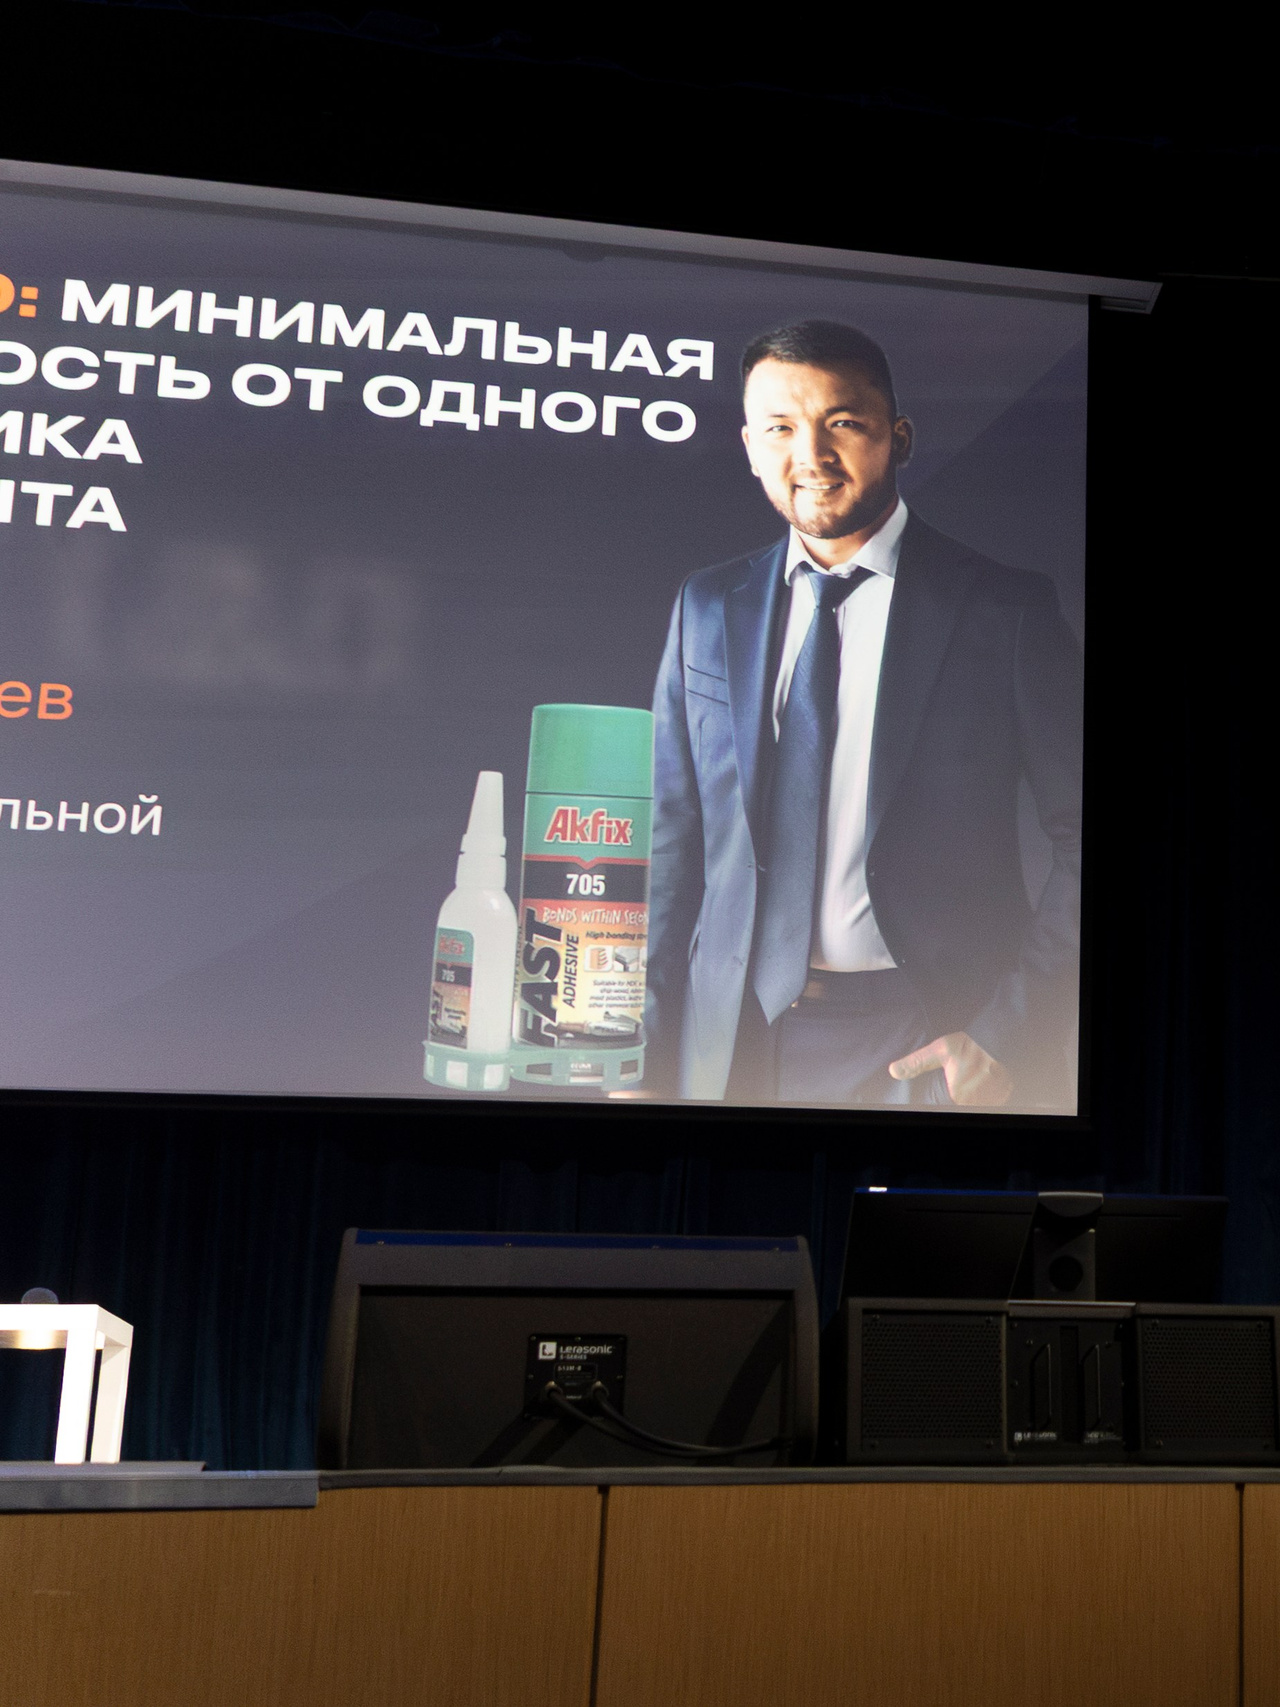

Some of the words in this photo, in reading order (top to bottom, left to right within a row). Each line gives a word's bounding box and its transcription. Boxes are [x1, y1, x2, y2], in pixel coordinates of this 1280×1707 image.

[61, 278, 715, 381] МИНИМАЛЬНАЯ
[231, 363, 344, 411] ОТ
[362, 375, 697, 443] ОДНОГО
[0, 479, 127, 532] ТА
[0, 680, 73, 720] ев
[544, 806, 633, 846] Akfix
[566, 873, 606, 896] 705
[582, 908, 620, 925] WITHIN
[519, 906, 563, 1048] FAST
[562, 933, 580, 1009] ADHESIVE
[559, 1344, 614, 1355] Lerasonic
